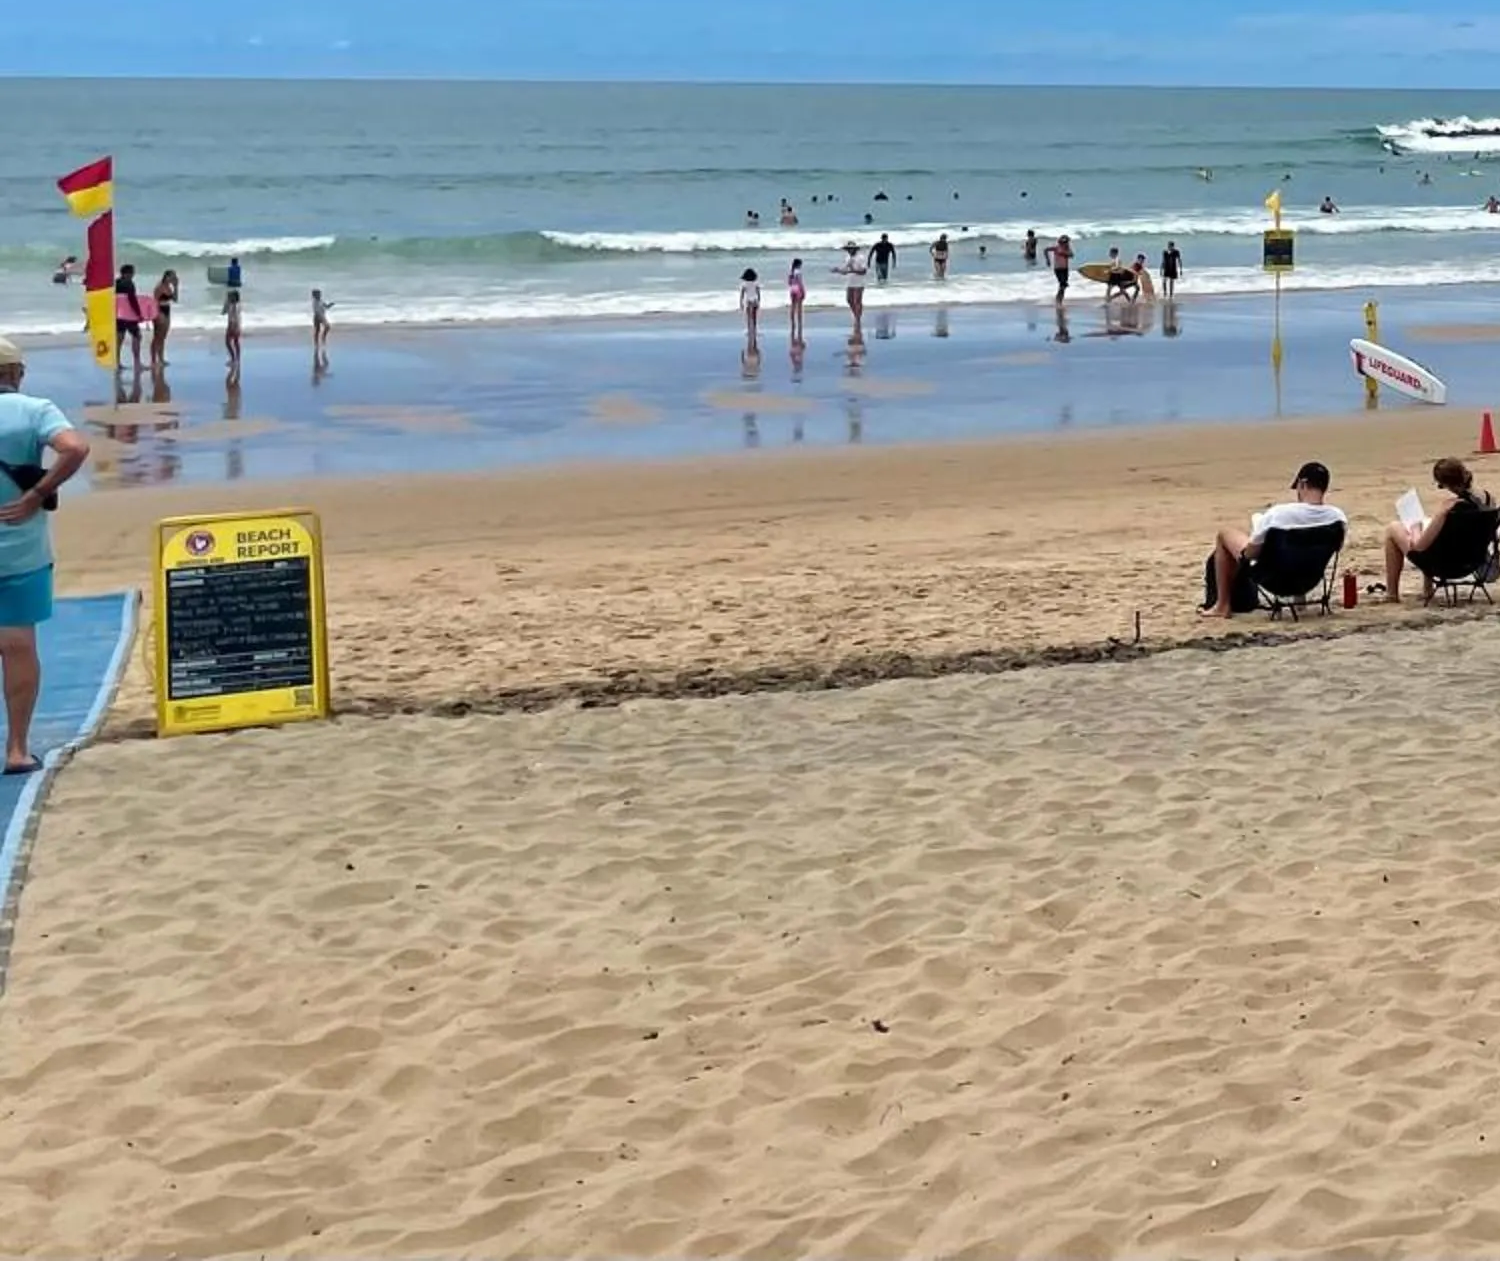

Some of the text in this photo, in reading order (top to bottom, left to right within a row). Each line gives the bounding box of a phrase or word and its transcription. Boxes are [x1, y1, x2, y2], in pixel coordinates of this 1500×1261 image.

[1369, 358, 1421, 388] LIFEGUARD
[237, 529, 291, 543] BEACH
[237, 542, 299, 558] REPORT
